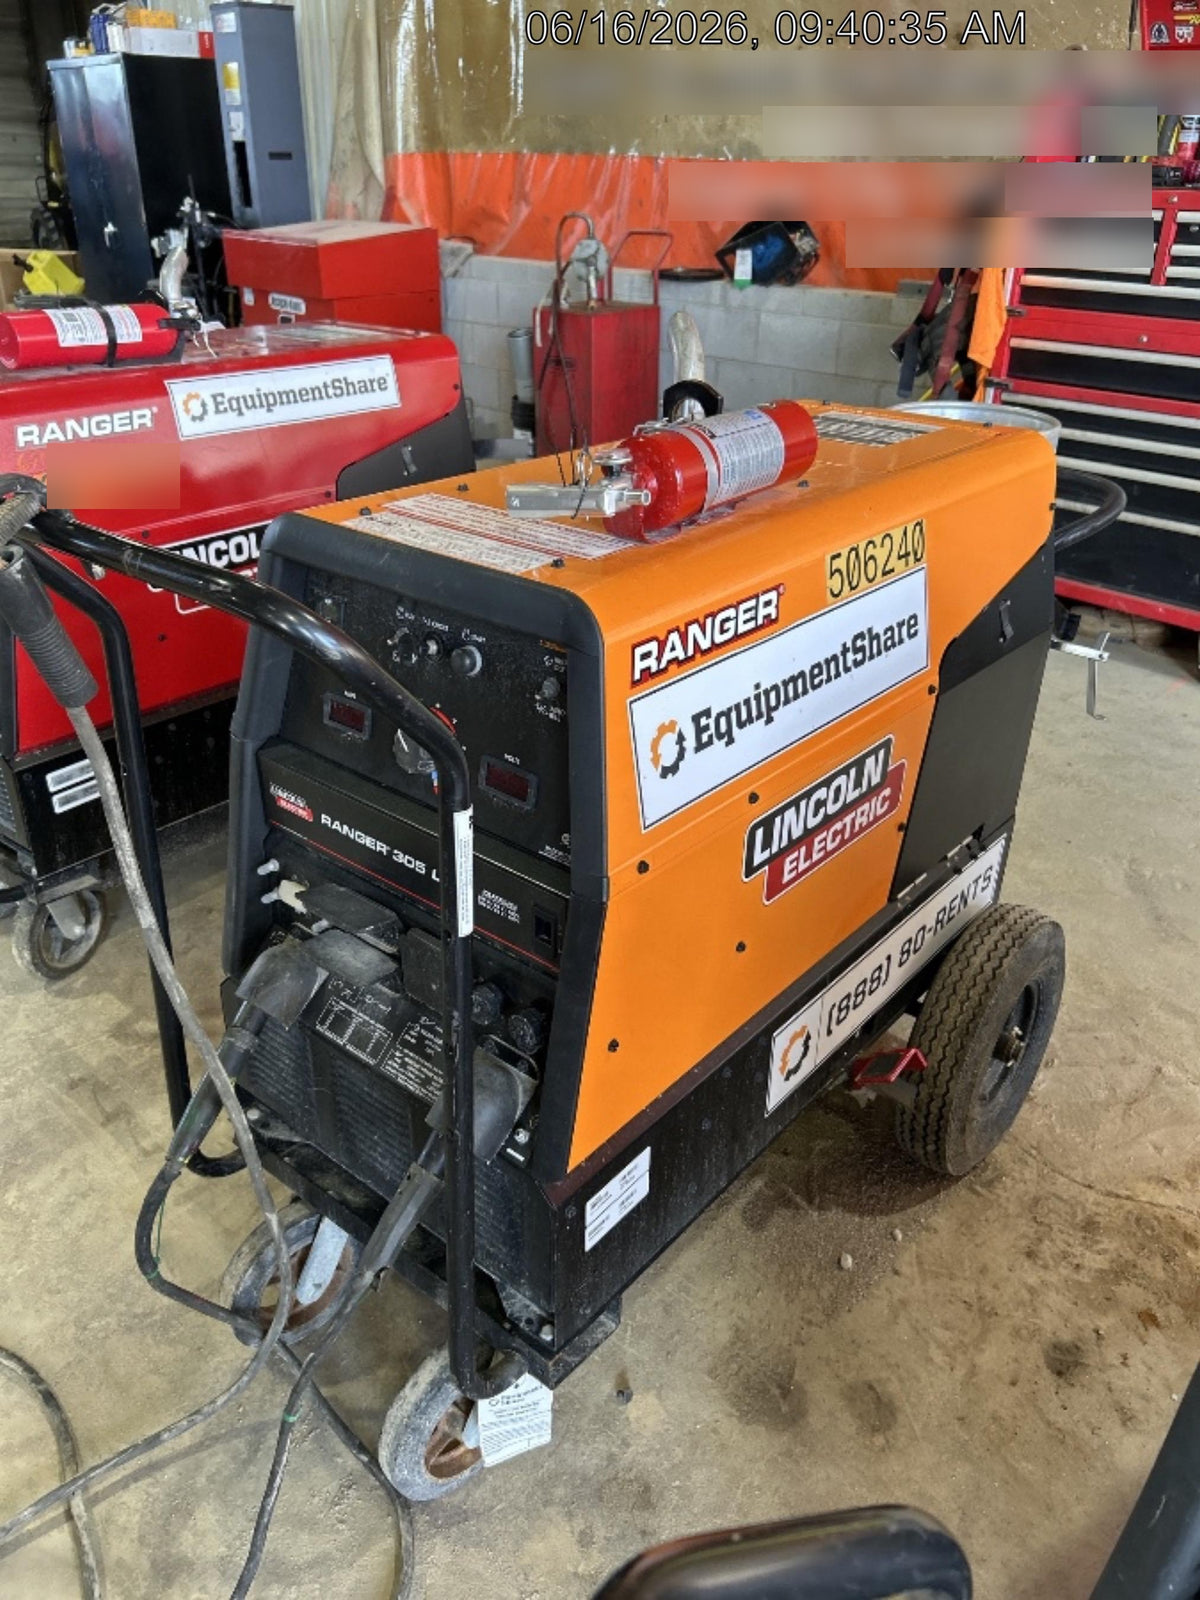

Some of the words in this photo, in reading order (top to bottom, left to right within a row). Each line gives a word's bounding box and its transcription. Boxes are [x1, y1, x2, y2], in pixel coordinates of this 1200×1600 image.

[16, 408, 153, 448] RANGER
[210, 376, 389, 418] EquipmentShare
[828, 518, 926, 599] 506240
[631, 590, 779, 683] RANGER
[691, 612, 919, 754] EquipmentShare
[320, 812, 387, 857] RANGER
[392, 848, 426, 875] 305
[752, 748, 886, 867] LINCOLN
[781, 786, 892, 885] ELECTRIC
[826, 953, 892, 1037] (888)
[897, 864, 994, 968] 80-RENTS
